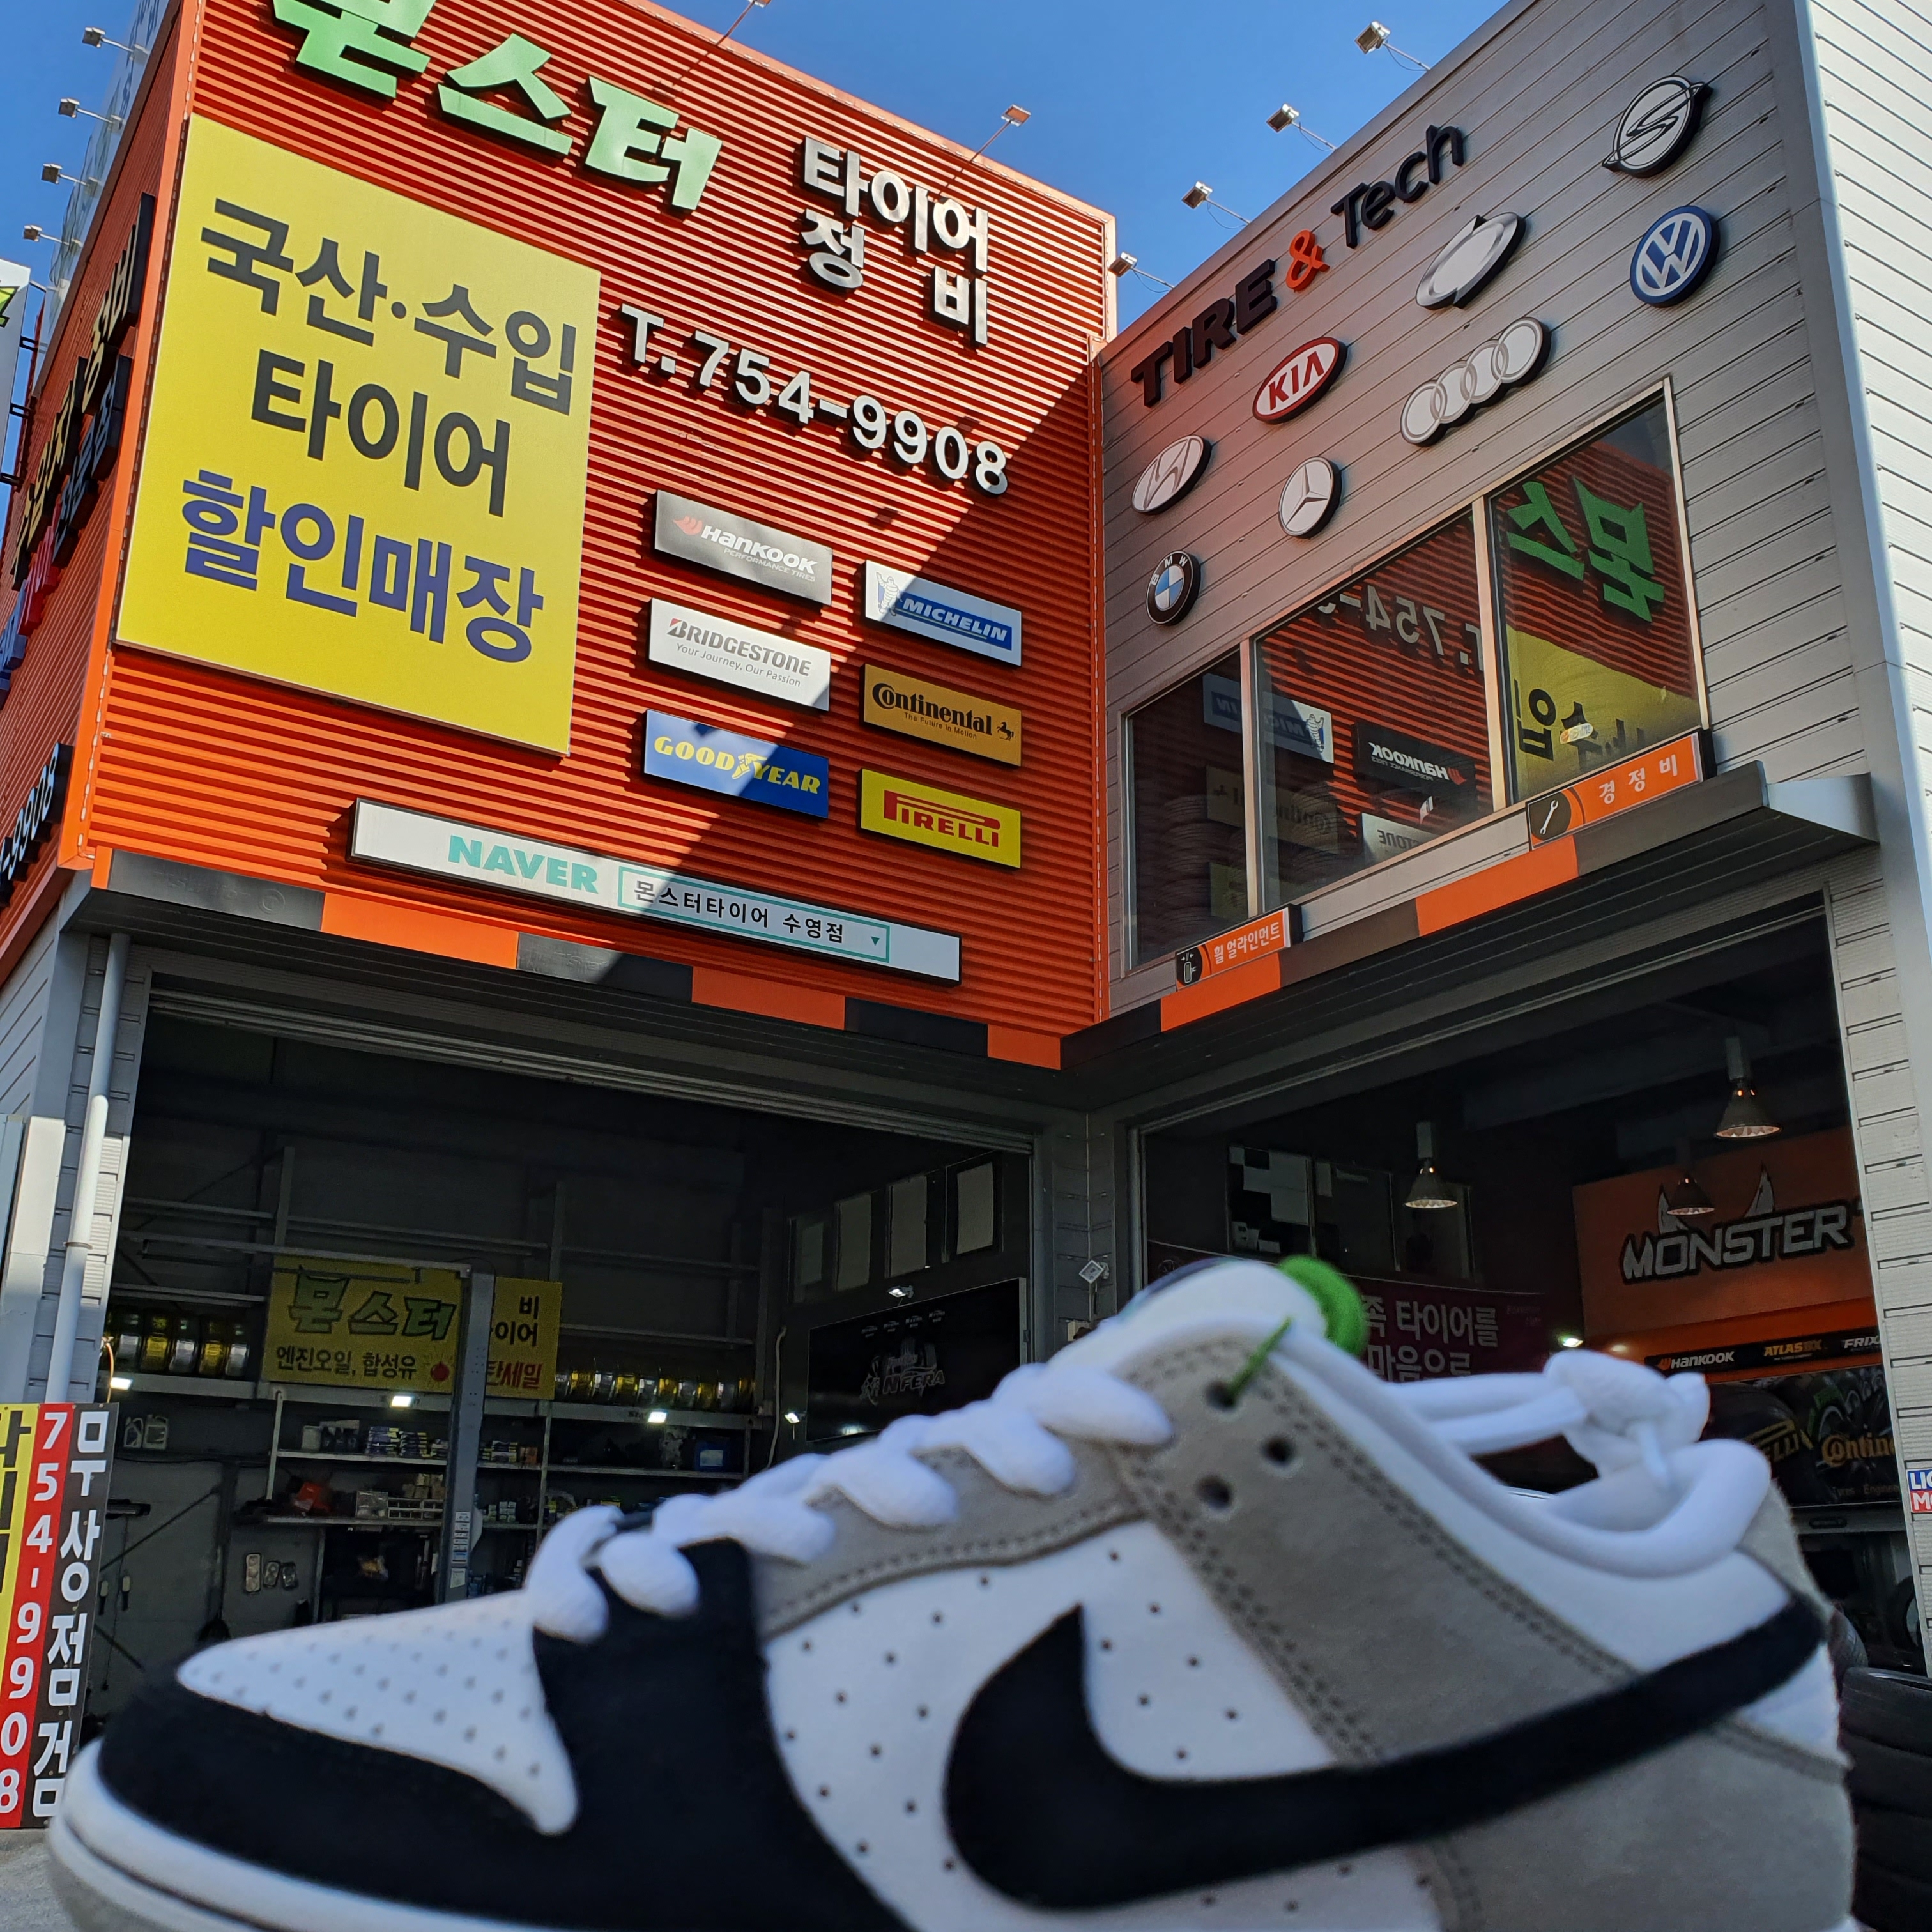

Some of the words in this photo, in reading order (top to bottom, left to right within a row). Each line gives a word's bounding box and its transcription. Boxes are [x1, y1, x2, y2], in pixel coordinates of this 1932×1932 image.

[804, 136, 988, 273] 타이어
[1130, 259, 1278, 408] TIRE
[1285, 229, 1330, 292] &
[1330, 124, 1464, 249] Tech
[1268, 351, 1325, 411] KIA
[251, 349, 511, 518] 타이어
[181, 469, 544, 663] 할인매장
[724, 548, 790, 574] PERFORMANCE
[792, 569, 815, 582] TIRES
[1151, 555, 1188, 586] BMW
[667, 618, 812, 676] BRIDGESTONE
[903, 597, 1008, 641] MICHELIN
[677, 643, 700, 657] Your
[746, 664, 764, 676] Our
[766, 670, 801, 687] Passion
[872, 683, 992, 735] Continental
[904, 712, 917, 722] The
[920, 716, 943, 729] Future
[954, 726, 977, 740] Motion
[884, 790, 1000, 848] PIRELLI
[448, 835, 599, 894] NAVER
[634, 879, 769, 928] 몬스터타이어
[783, 913, 845, 944] 수영점
[1214, 944, 1224, 965] 휠
[1226, 921, 1280, 960] 얼라인먼트
[1623, 1206, 1850, 1280] MONSTER
[289, 1275, 457, 1341] 몬스터
[491, 1321, 538, 1347] 이어
[1395, 1300, 1499, 1347] 타이어를
[362, 1352, 418, 1381] 합성유
[0, 1412, 68, 1817] 754-9908
